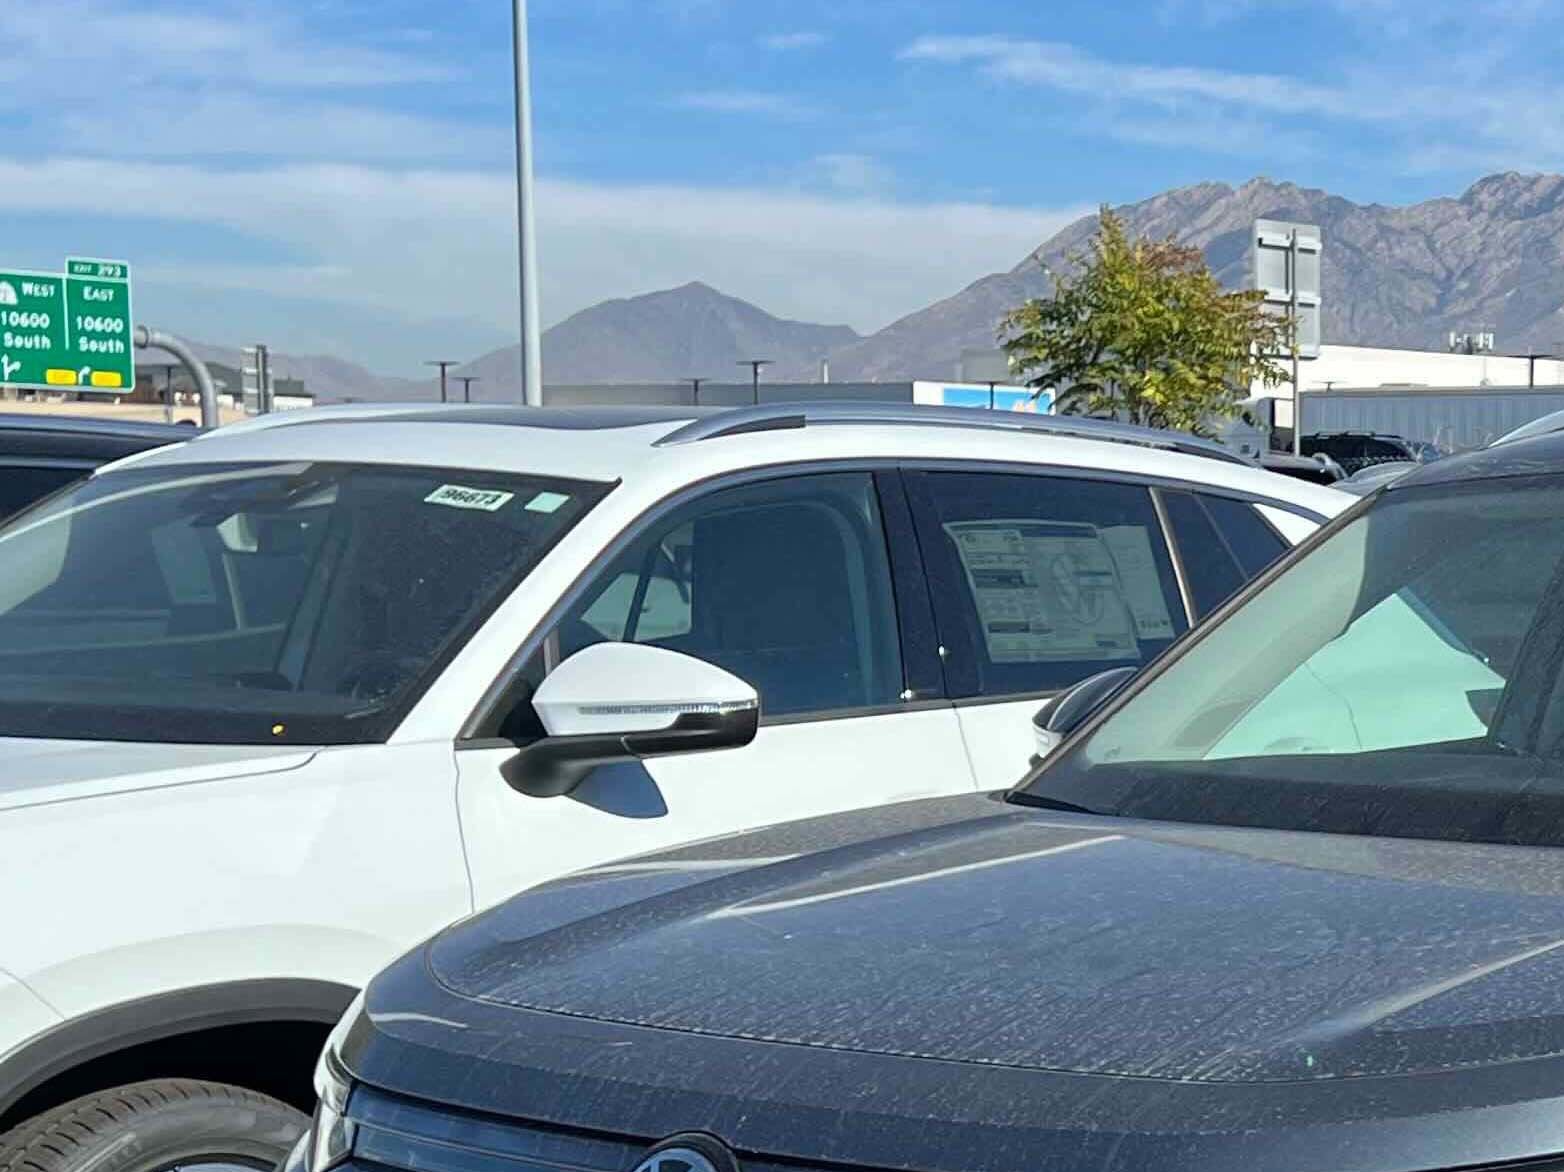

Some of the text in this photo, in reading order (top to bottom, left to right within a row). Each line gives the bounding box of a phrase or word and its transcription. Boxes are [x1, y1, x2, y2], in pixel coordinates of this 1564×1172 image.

[22, 282, 55, 298] WEST
[83, 286, 114, 302] EAST
[1, 312, 50, 329] 10600
[76, 315, 124, 334] 10600
[3, 331, 51, 349] South
[78, 336, 124, 354] South
